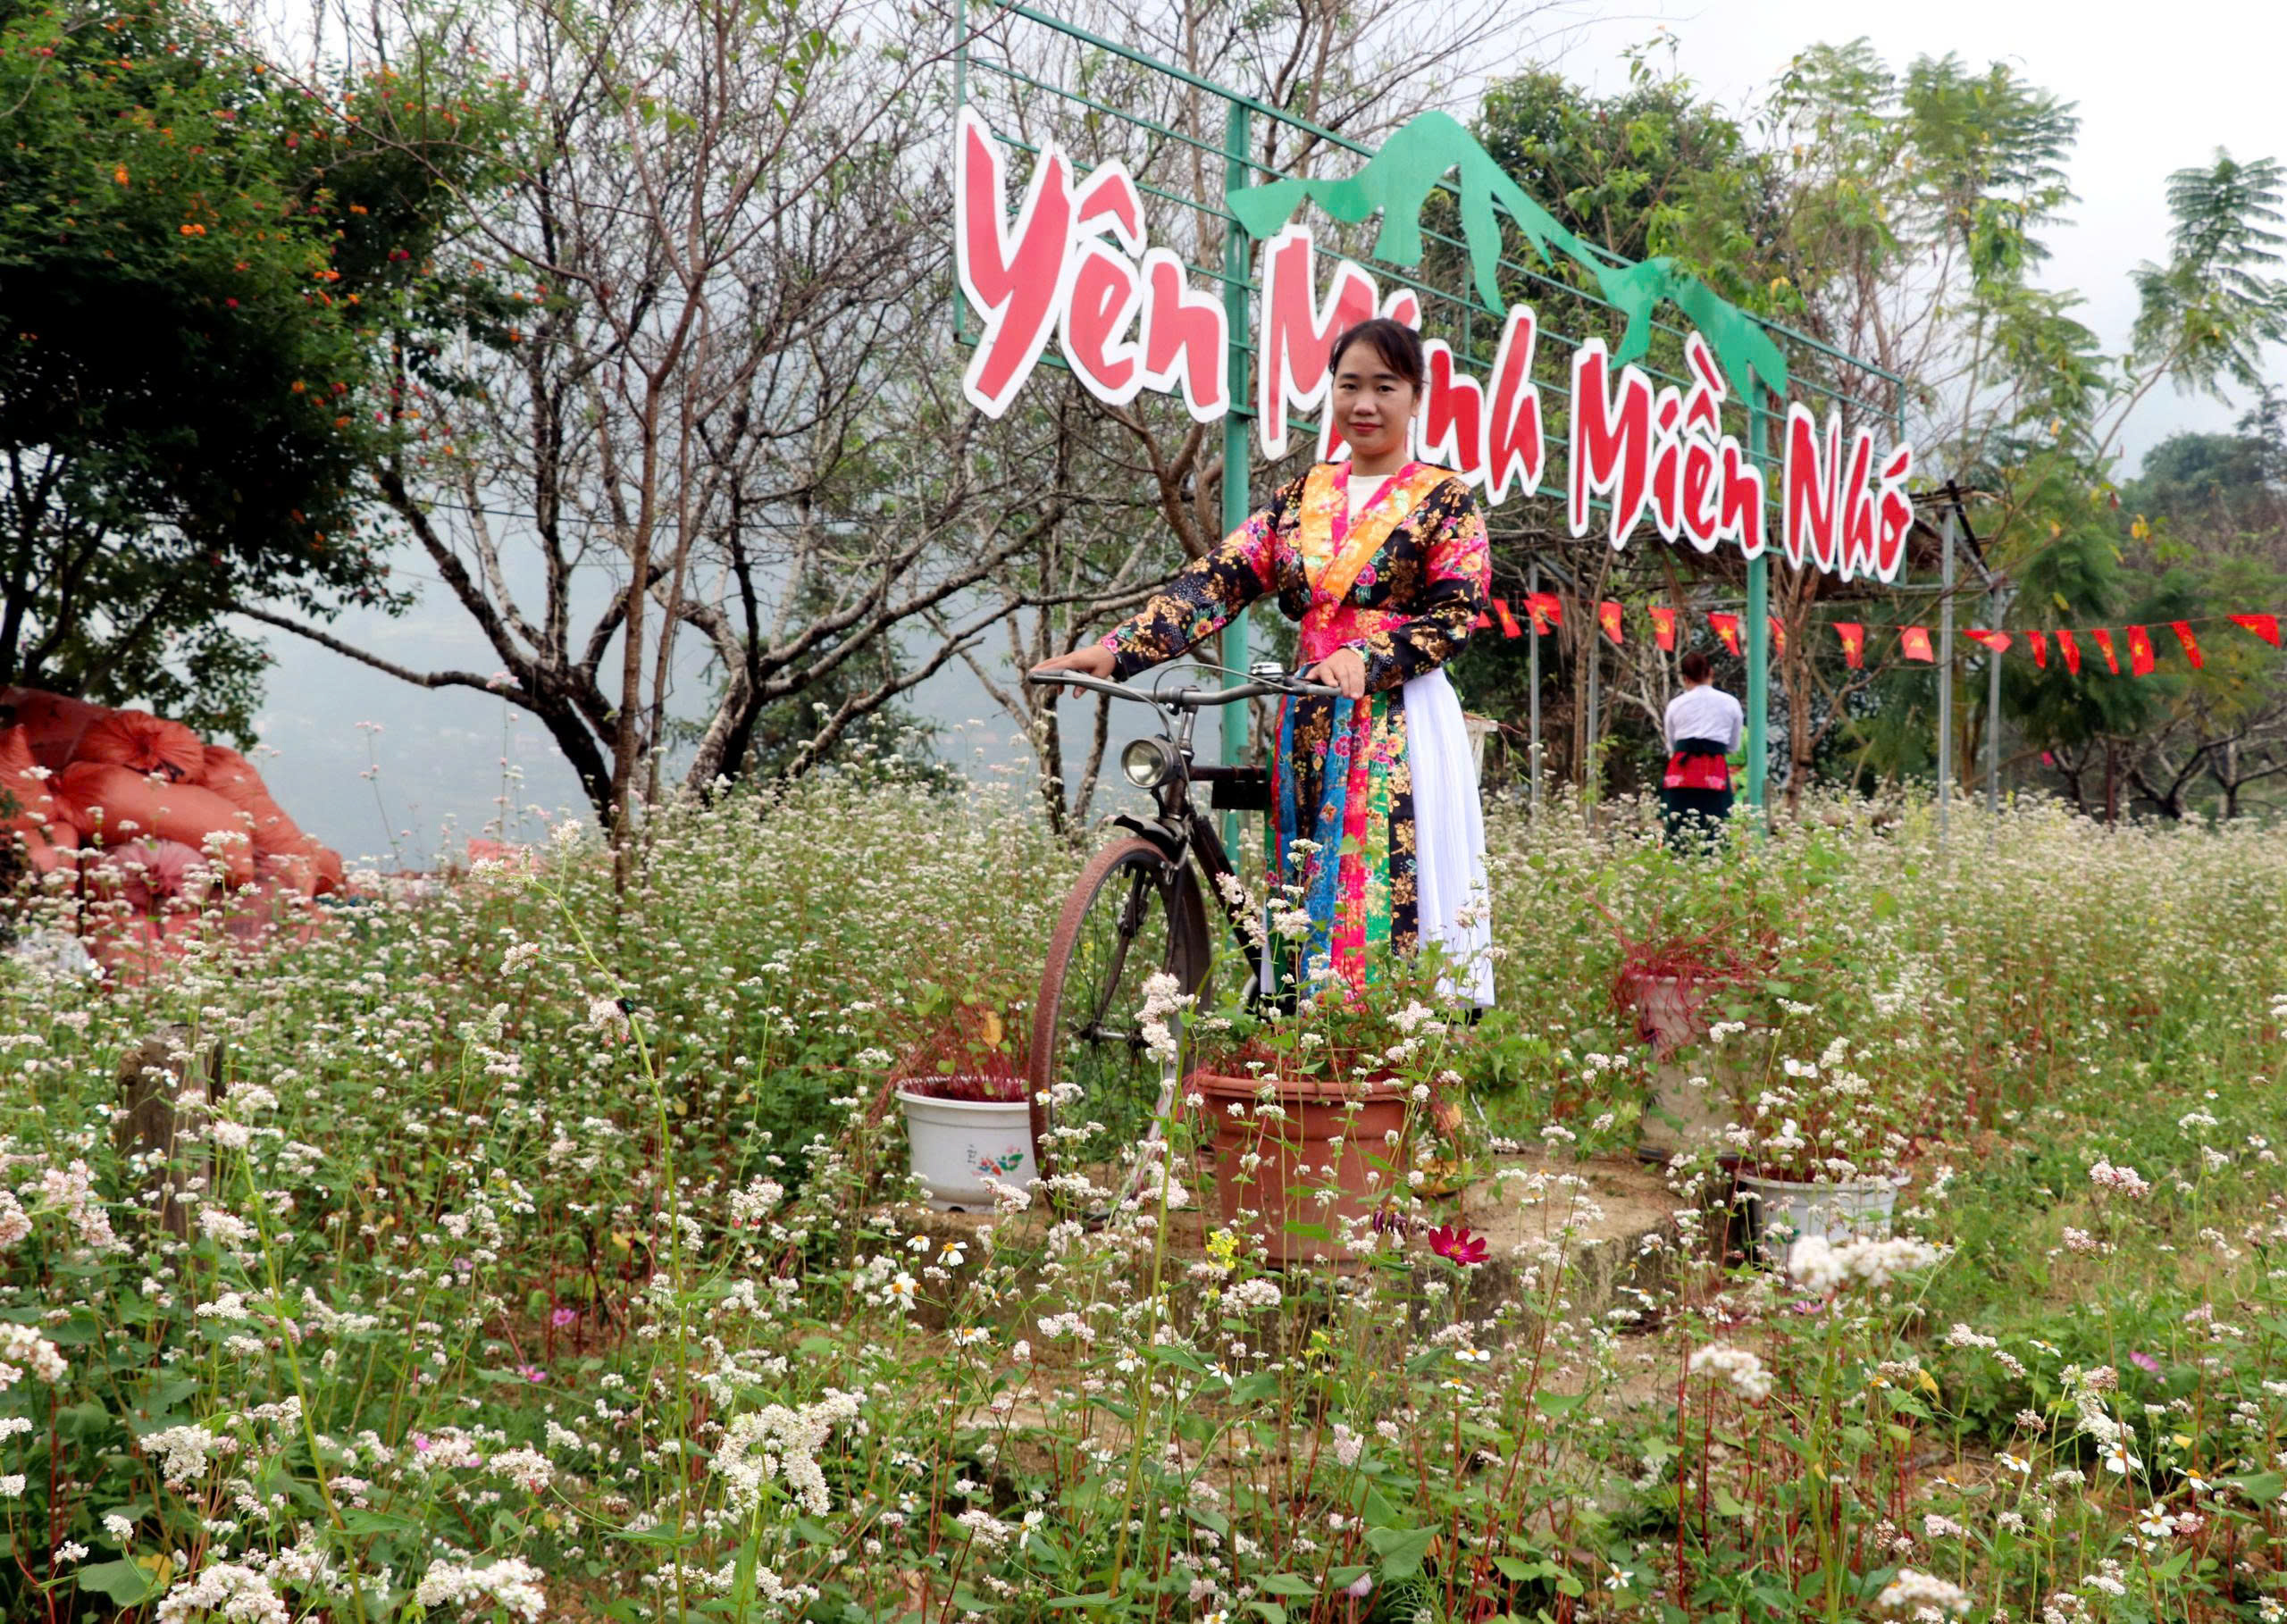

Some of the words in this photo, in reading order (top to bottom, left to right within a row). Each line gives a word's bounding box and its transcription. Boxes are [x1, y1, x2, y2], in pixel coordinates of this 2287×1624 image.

[958, 107, 1228, 421] Yên
[1261, 226, 1545, 505] Mnh
[1571, 331, 1764, 558] Miền
[1784, 403, 1913, 582] Nhớ
